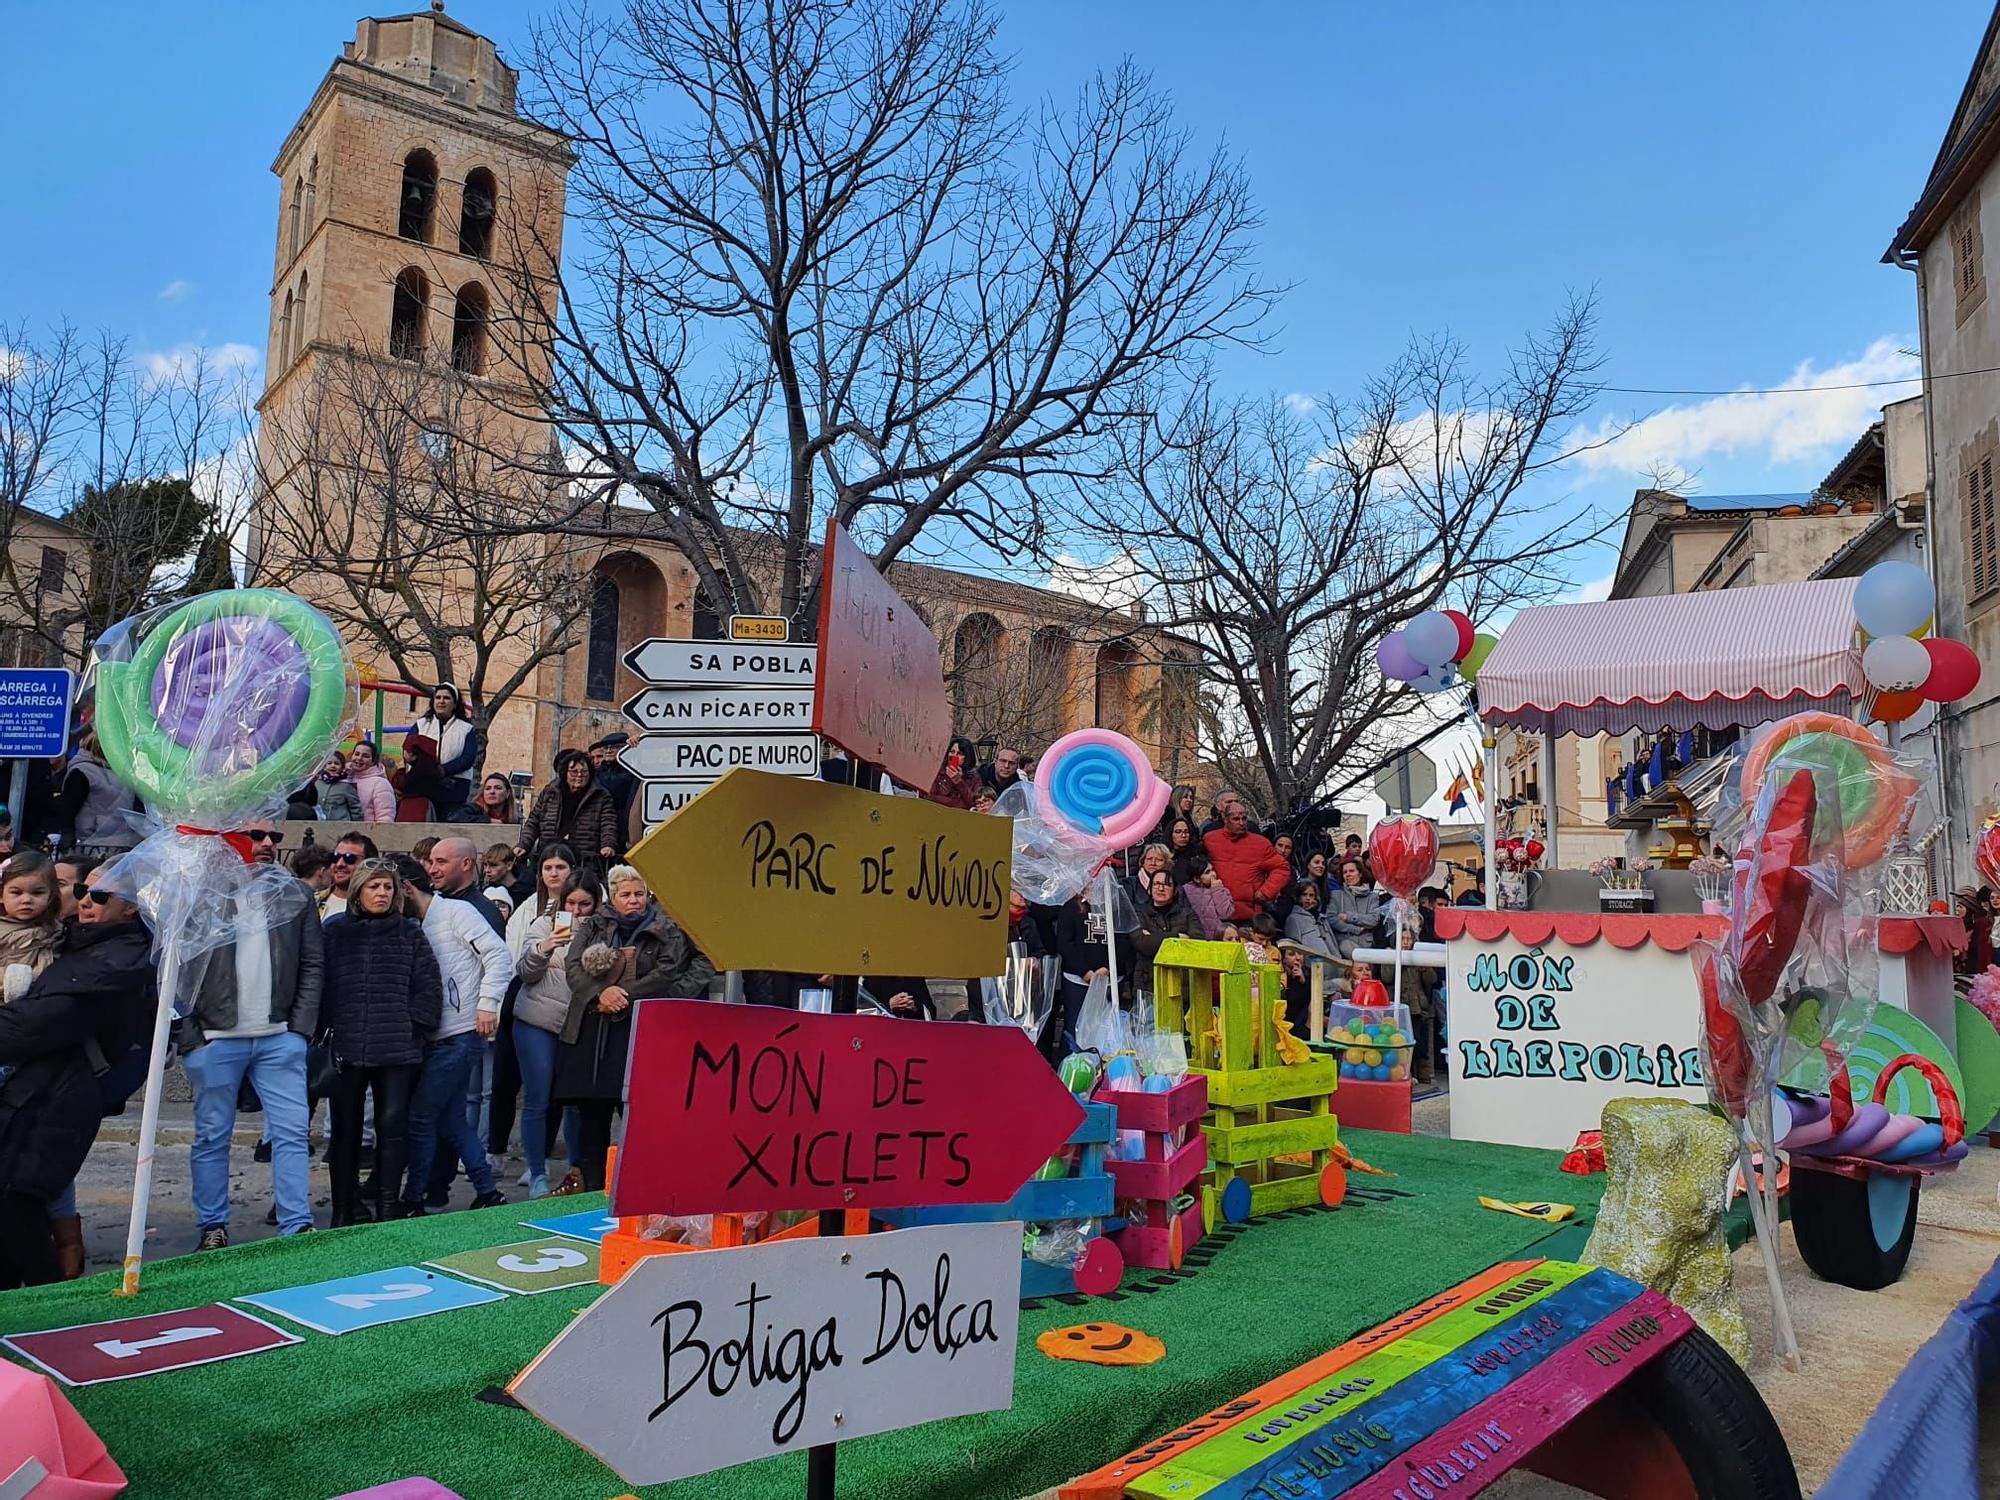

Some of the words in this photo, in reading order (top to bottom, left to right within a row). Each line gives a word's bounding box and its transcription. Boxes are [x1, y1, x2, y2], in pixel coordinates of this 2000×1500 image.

[735, 623, 783, 635] Ma-3430
[689, 653, 722, 671] SA
[732, 655, 813, 674] POBLA
[646, 702, 693, 718] CAN
[676, 744, 724, 768] PAC
[729, 746, 753, 765] DE
[758, 745, 813, 765] MURO
[742, 820, 836, 895] PARC
[860, 846, 895, 895] DE
[1467, 947, 1574, 992] MÓN
[1495, 994, 1561, 1031] DE
[685, 1023, 826, 1117] MÓN
[872, 1057, 929, 1109] DE
[726, 1130, 972, 1190] XICLETS
[496, 1247, 590, 1274] 3
[325, 1283, 434, 1310] 2
[647, 1282, 843, 1445] Botiga
[862, 1252, 999, 1362] Dolça
